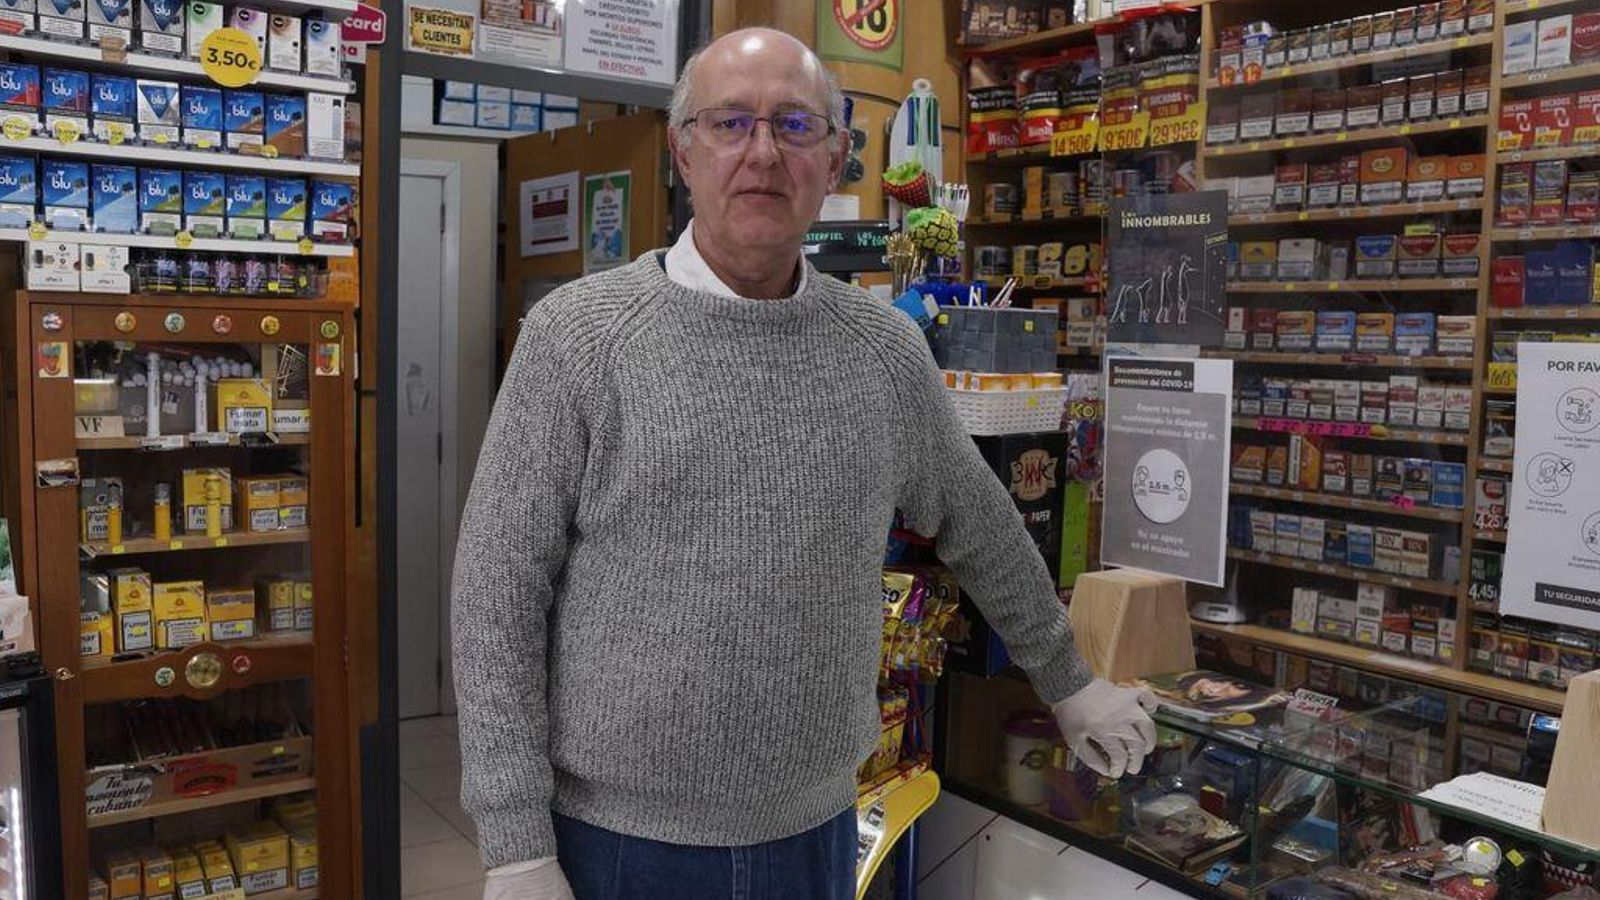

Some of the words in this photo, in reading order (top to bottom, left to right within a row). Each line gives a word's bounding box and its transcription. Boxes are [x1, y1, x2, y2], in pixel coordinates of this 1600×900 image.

[153, 4, 171, 17] blu
[343, 14, 382, 33] card
[413, 11, 425, 24] SE
[426, 13, 471, 30] NECESITAN
[422, 30, 462, 45] CLIENTES
[206, 47, 257, 71] 3,50€
[1, 76, 21, 91] blu
[52, 81, 73, 97] blu
[100, 86, 119, 102] blu
[150, 90, 167, 105] blu
[189, 101, 209, 115] blu
[232, 104, 250, 118] blu
[273, 109, 291, 122] blu
[52, 175, 71, 190] blu
[101, 180, 120, 194] blu
[150, 183, 166, 197] blu
[192, 187, 210, 200] blu
[234, 190, 251, 202] blu
[275, 192, 292, 205] blu
[321, 194, 337, 206] blu
[1121, 213, 1212, 228] INNOMBRABLES
[1547, 361, 1574, 372] POR
[1161, 379, 1193, 389] COVID-19
[229, 409, 263, 419] Fumar
[233, 418, 259, 428] mata
[1543, 589, 1554, 598] TU
